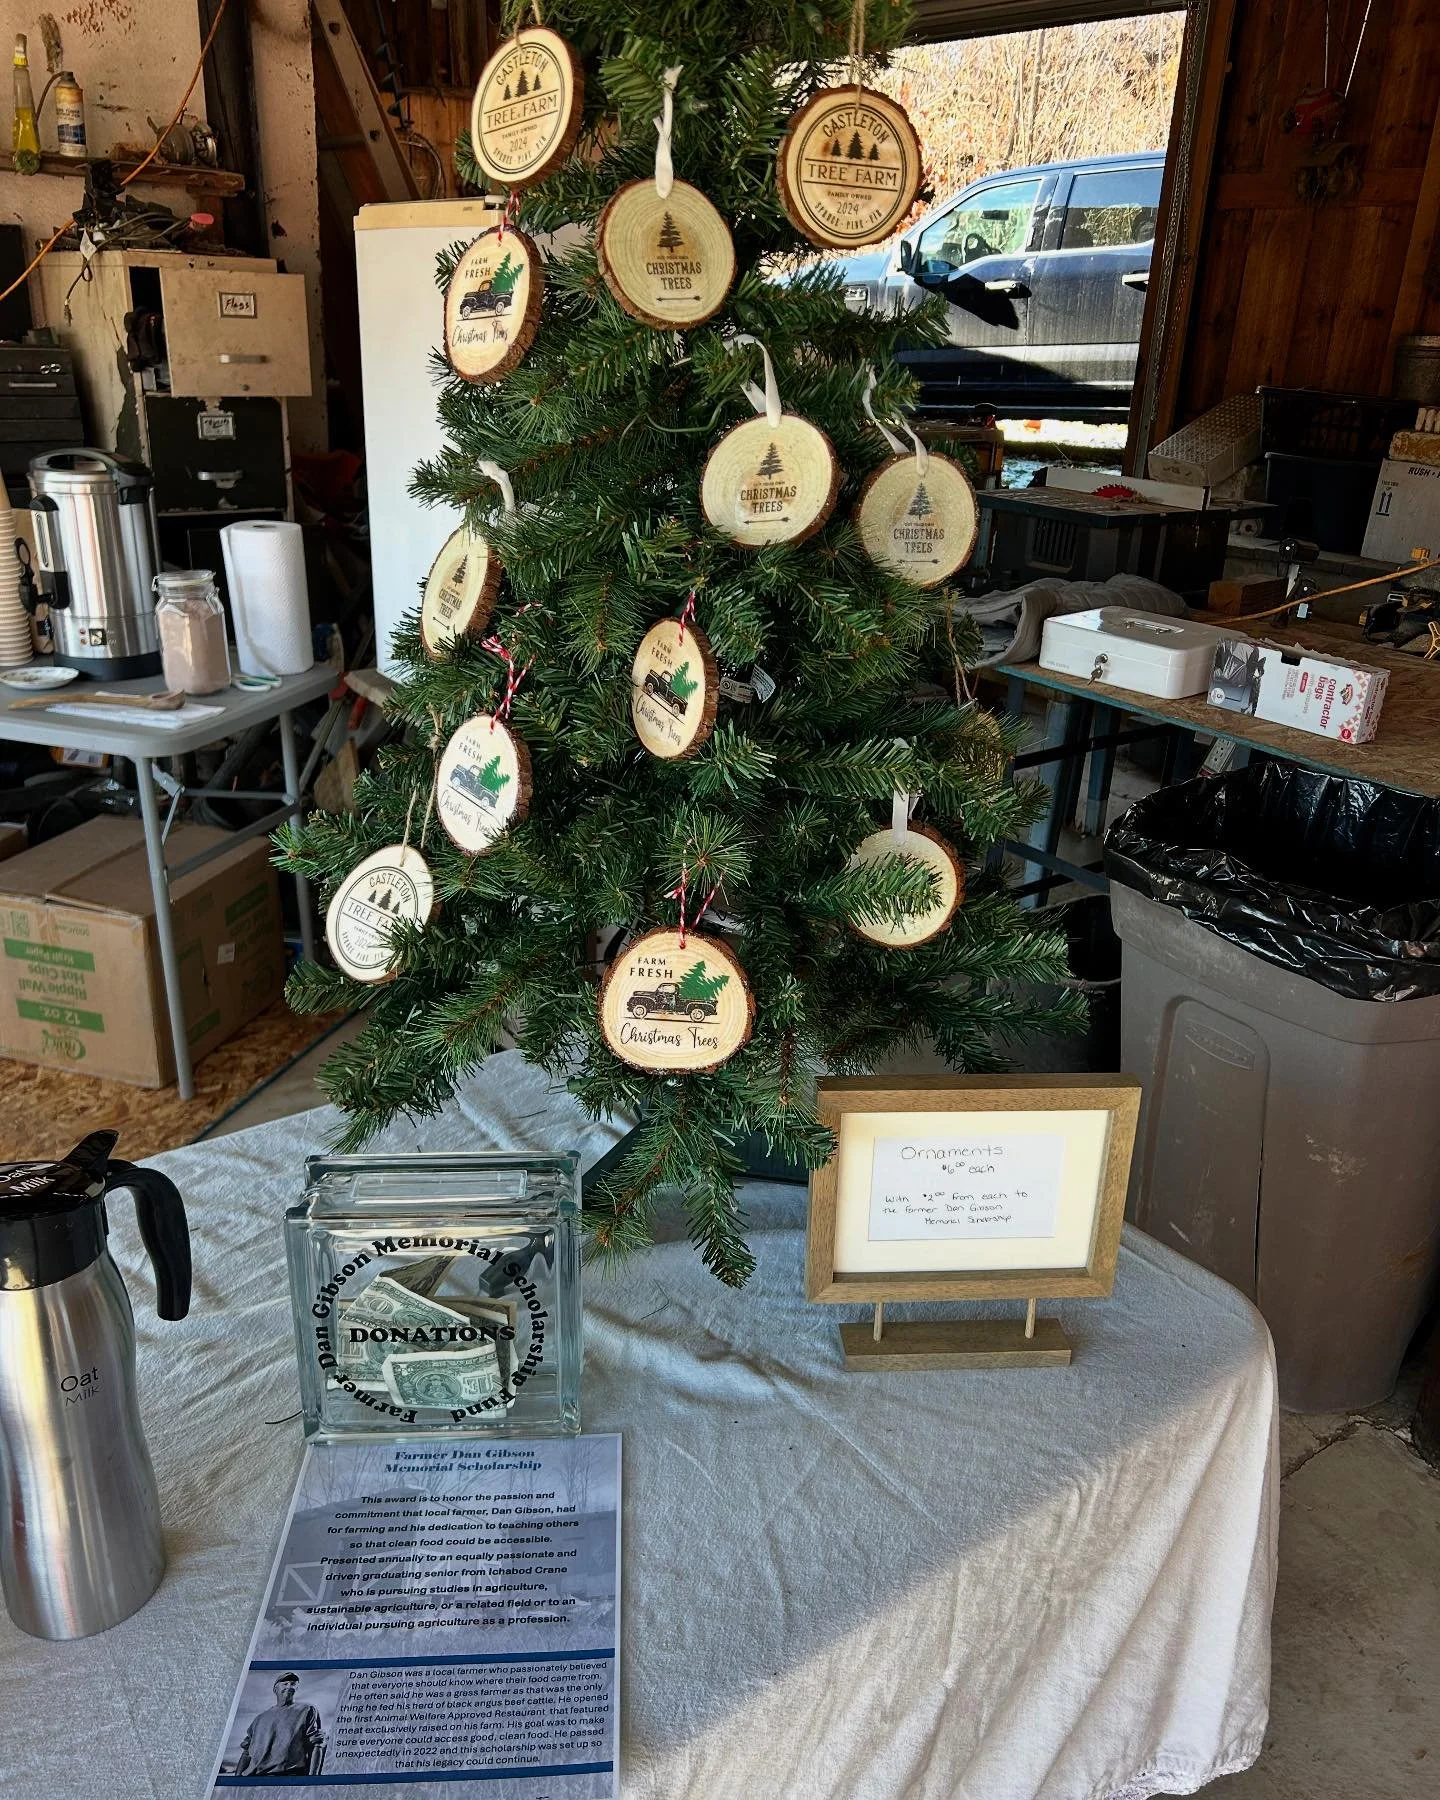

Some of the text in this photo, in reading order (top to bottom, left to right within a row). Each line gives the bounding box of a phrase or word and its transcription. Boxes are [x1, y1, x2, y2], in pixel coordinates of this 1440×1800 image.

[496, 50, 549, 86] CASTLETON
[486, 94, 557, 129] TREE FARM
[822, 111, 890, 144] CASTLETON
[510, 136, 528, 153] 2024
[808, 163, 897, 187] TREE FARM
[836, 202, 860, 215] 2024
[471, 257, 488, 265] FARM
[646, 262, 702, 275] CHRISTMAS
[465, 267, 491, 279] FRESH
[661, 277, 692, 290] TREES
[452, 325, 487, 347] Christmas
[1408, 467, 1430, 477] RUSH
[741, 486, 797, 500] CHRISTMAS
[752, 501, 783, 513] TREES
[893, 528, 945, 541] CHRISTMAS
[904, 541, 933, 554] TREES
[651, 648, 673, 669] FRESH
[1315, 676, 1328, 701] bags
[1320, 678, 1336, 730] contractor
[459, 742, 482, 763] FRESH
[369, 872, 412, 904] CASTLETON
[347, 902, 373, 921] TREE
[637, 956, 666, 966] FARM
[27, 962, 84, 984] Hot Cups
[629, 967, 673, 979] FRESH
[18, 978, 87, 1001] Ripple Wall
[64, 1009, 80, 1024] 12
[620, 1022, 719, 1049] Christmas Trees
[900, 1145, 1004, 1160] Ornaments
[968, 1164, 995, 1174] each
[9, 1176, 56, 1192] Milk
[981, 1190, 1008, 1200] each
[1015, 1189, 1028, 1198] to
[944, 1203, 965, 1212] Dan
[969, 1203, 1003, 1212] Gibson
[312, 1235, 548, 1424] Farmer Dan Gibson Memorial Scholarship Fund
[349, 1325, 515, 1343] DONATIONS
[61, 1367, 98, 1392] Oat
[66, 1387, 99, 1406] Milk
[395, 1448, 535, 1461] Farmer Dan Gibson
[384, 1461, 541, 1473] Memorial Scholarship
[361, 1496, 381, 1504] This
[385, 1495, 416, 1503] award
[442, 1494, 473, 1502] honor
[475, 1493, 491, 1501] the
[494, 1492, 534, 1502] passion
[536, 1491, 555, 1499] and
[335, 1511, 400, 1519] commitment
[425, 1509, 450, 1517] local
[452, 1508, 488, 1516] farmer,
[491, 1507, 511, 1515] Dan
[514, 1506, 554, 1514] Gibson,
[556, 1505, 576, 1513] had
[327, 1526, 343, 1534] for
[344, 1525, 385, 1535] farming
[388, 1524, 408, 1532] and
[428, 1522, 483, 1531] dedication
[485, 1522, 496, 1530] to
[498, 1521, 543, 1530] teaching
[545, 1520, 579, 1528] others
[388, 1539, 417, 1547] clean
[419, 1538, 443, 1546] food
[445, 1537, 475, 1546] could
[478, 1537, 491, 1545] be
[493, 1536, 552, 1544] accessible.
[320, 1556, 376, 1565] Presented
[378, 1554, 424, 1564] annually
[426, 1554, 437, 1562] to
[455, 1552, 494, 1561] equally
[496, 1551, 554, 1560] passionate
[556, 1549, 577, 1557] and
[326, 1566, 568, 1581] driven graduating senior from Ichabod Crane
[340, 1582, 548, 1597] who is pursuing studies in agriculture,
[307, 1605, 371, 1614] sustainable
[374, 1602, 438, 1613] agriculture,
[441, 1602, 453, 1610] or
[465, 1600, 504, 1609] related
[507, 1599, 532, 1607] field
[534, 1599, 546, 1607] or
[548, 1598, 560, 1606] to
[307, 1621, 362, 1631] individual
[364, 1620, 415, 1631] pursuing
[417, 1617, 479, 1628] agriculture
[507, 1614, 570, 1626] profession.
[349, 1671, 368, 1679] Dan
[370, 1670, 402, 1678] Gibson
[432, 1668, 455, 1676] local
[457, 1666, 487, 1675] farmer
[489, 1666, 508, 1674] who
[510, 1663, 567, 1674] passionately
[569, 1662, 607, 1671] believed
